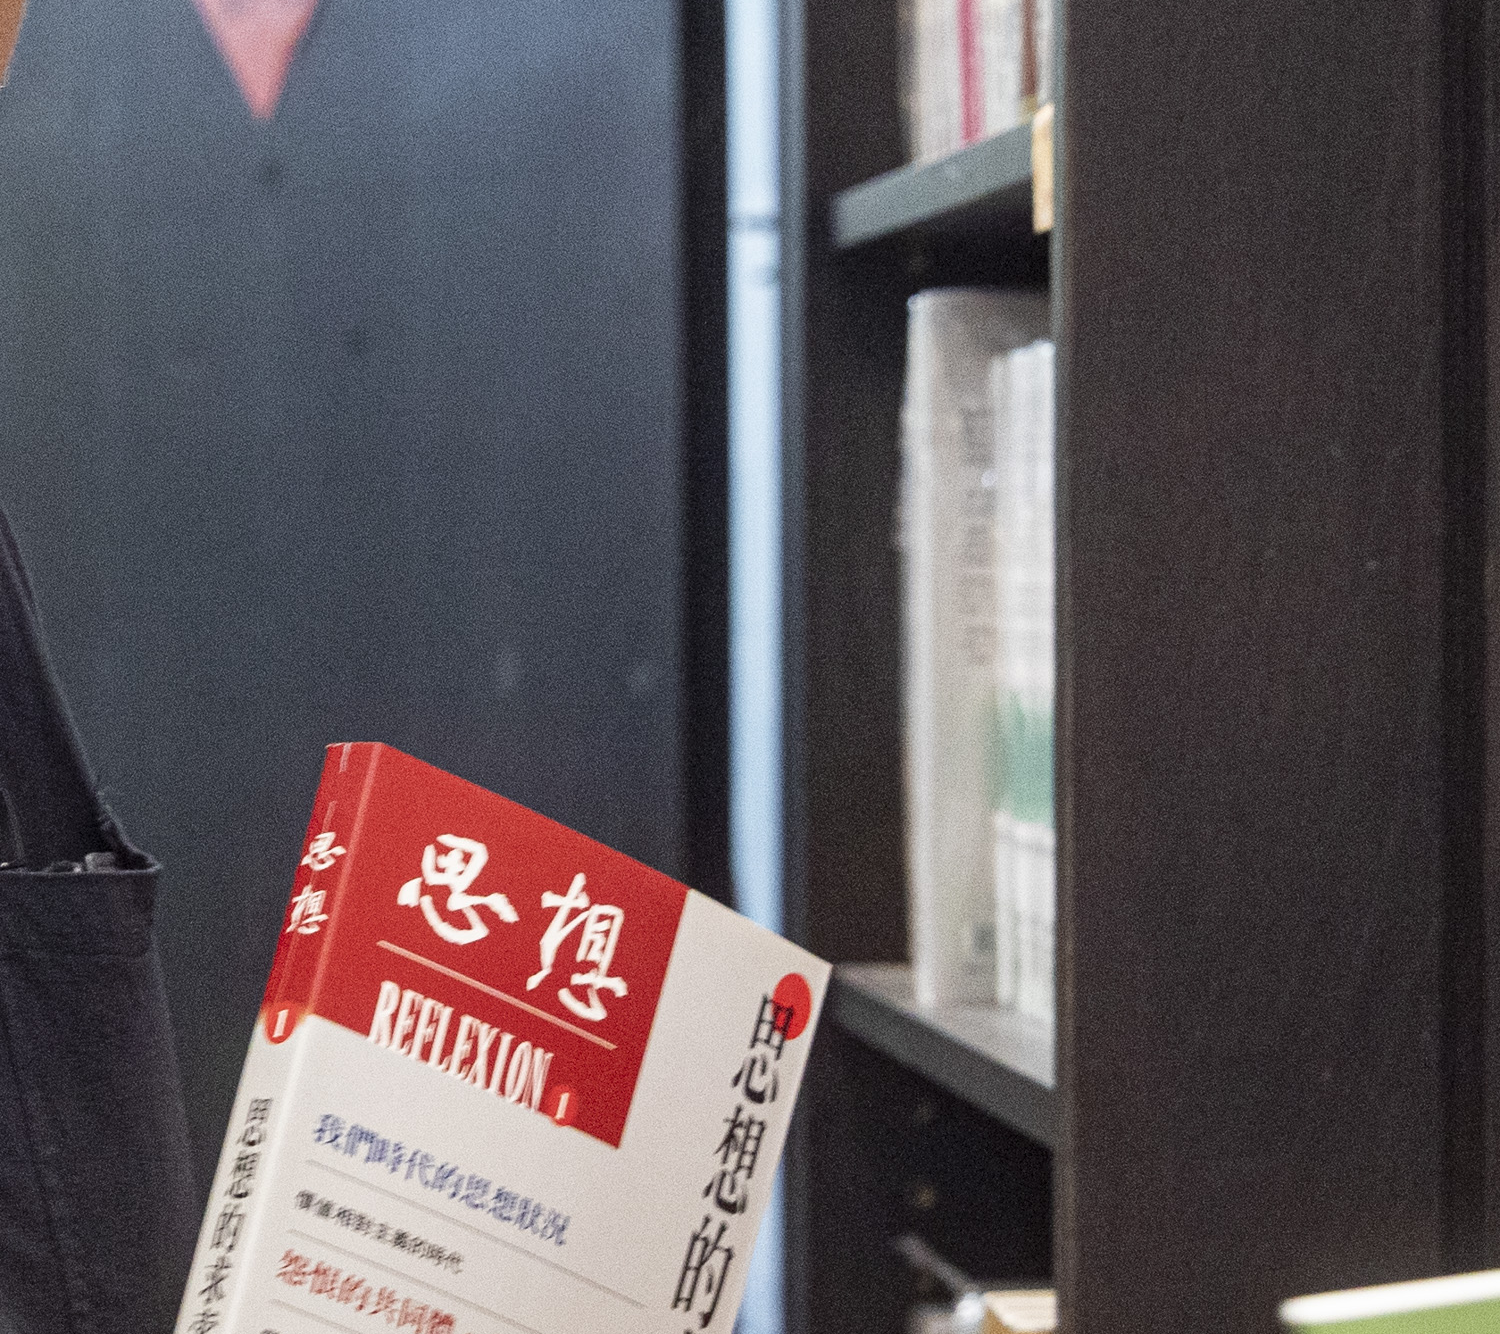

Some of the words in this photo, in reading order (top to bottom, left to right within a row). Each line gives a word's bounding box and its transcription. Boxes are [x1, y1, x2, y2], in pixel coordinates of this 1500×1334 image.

[287, 830, 346, 935] 思想
[399, 833, 632, 1021] 思想
[368, 979, 554, 1117] REFLEXION
[313, 1112, 572, 1247] 我們時代的思想狀況
